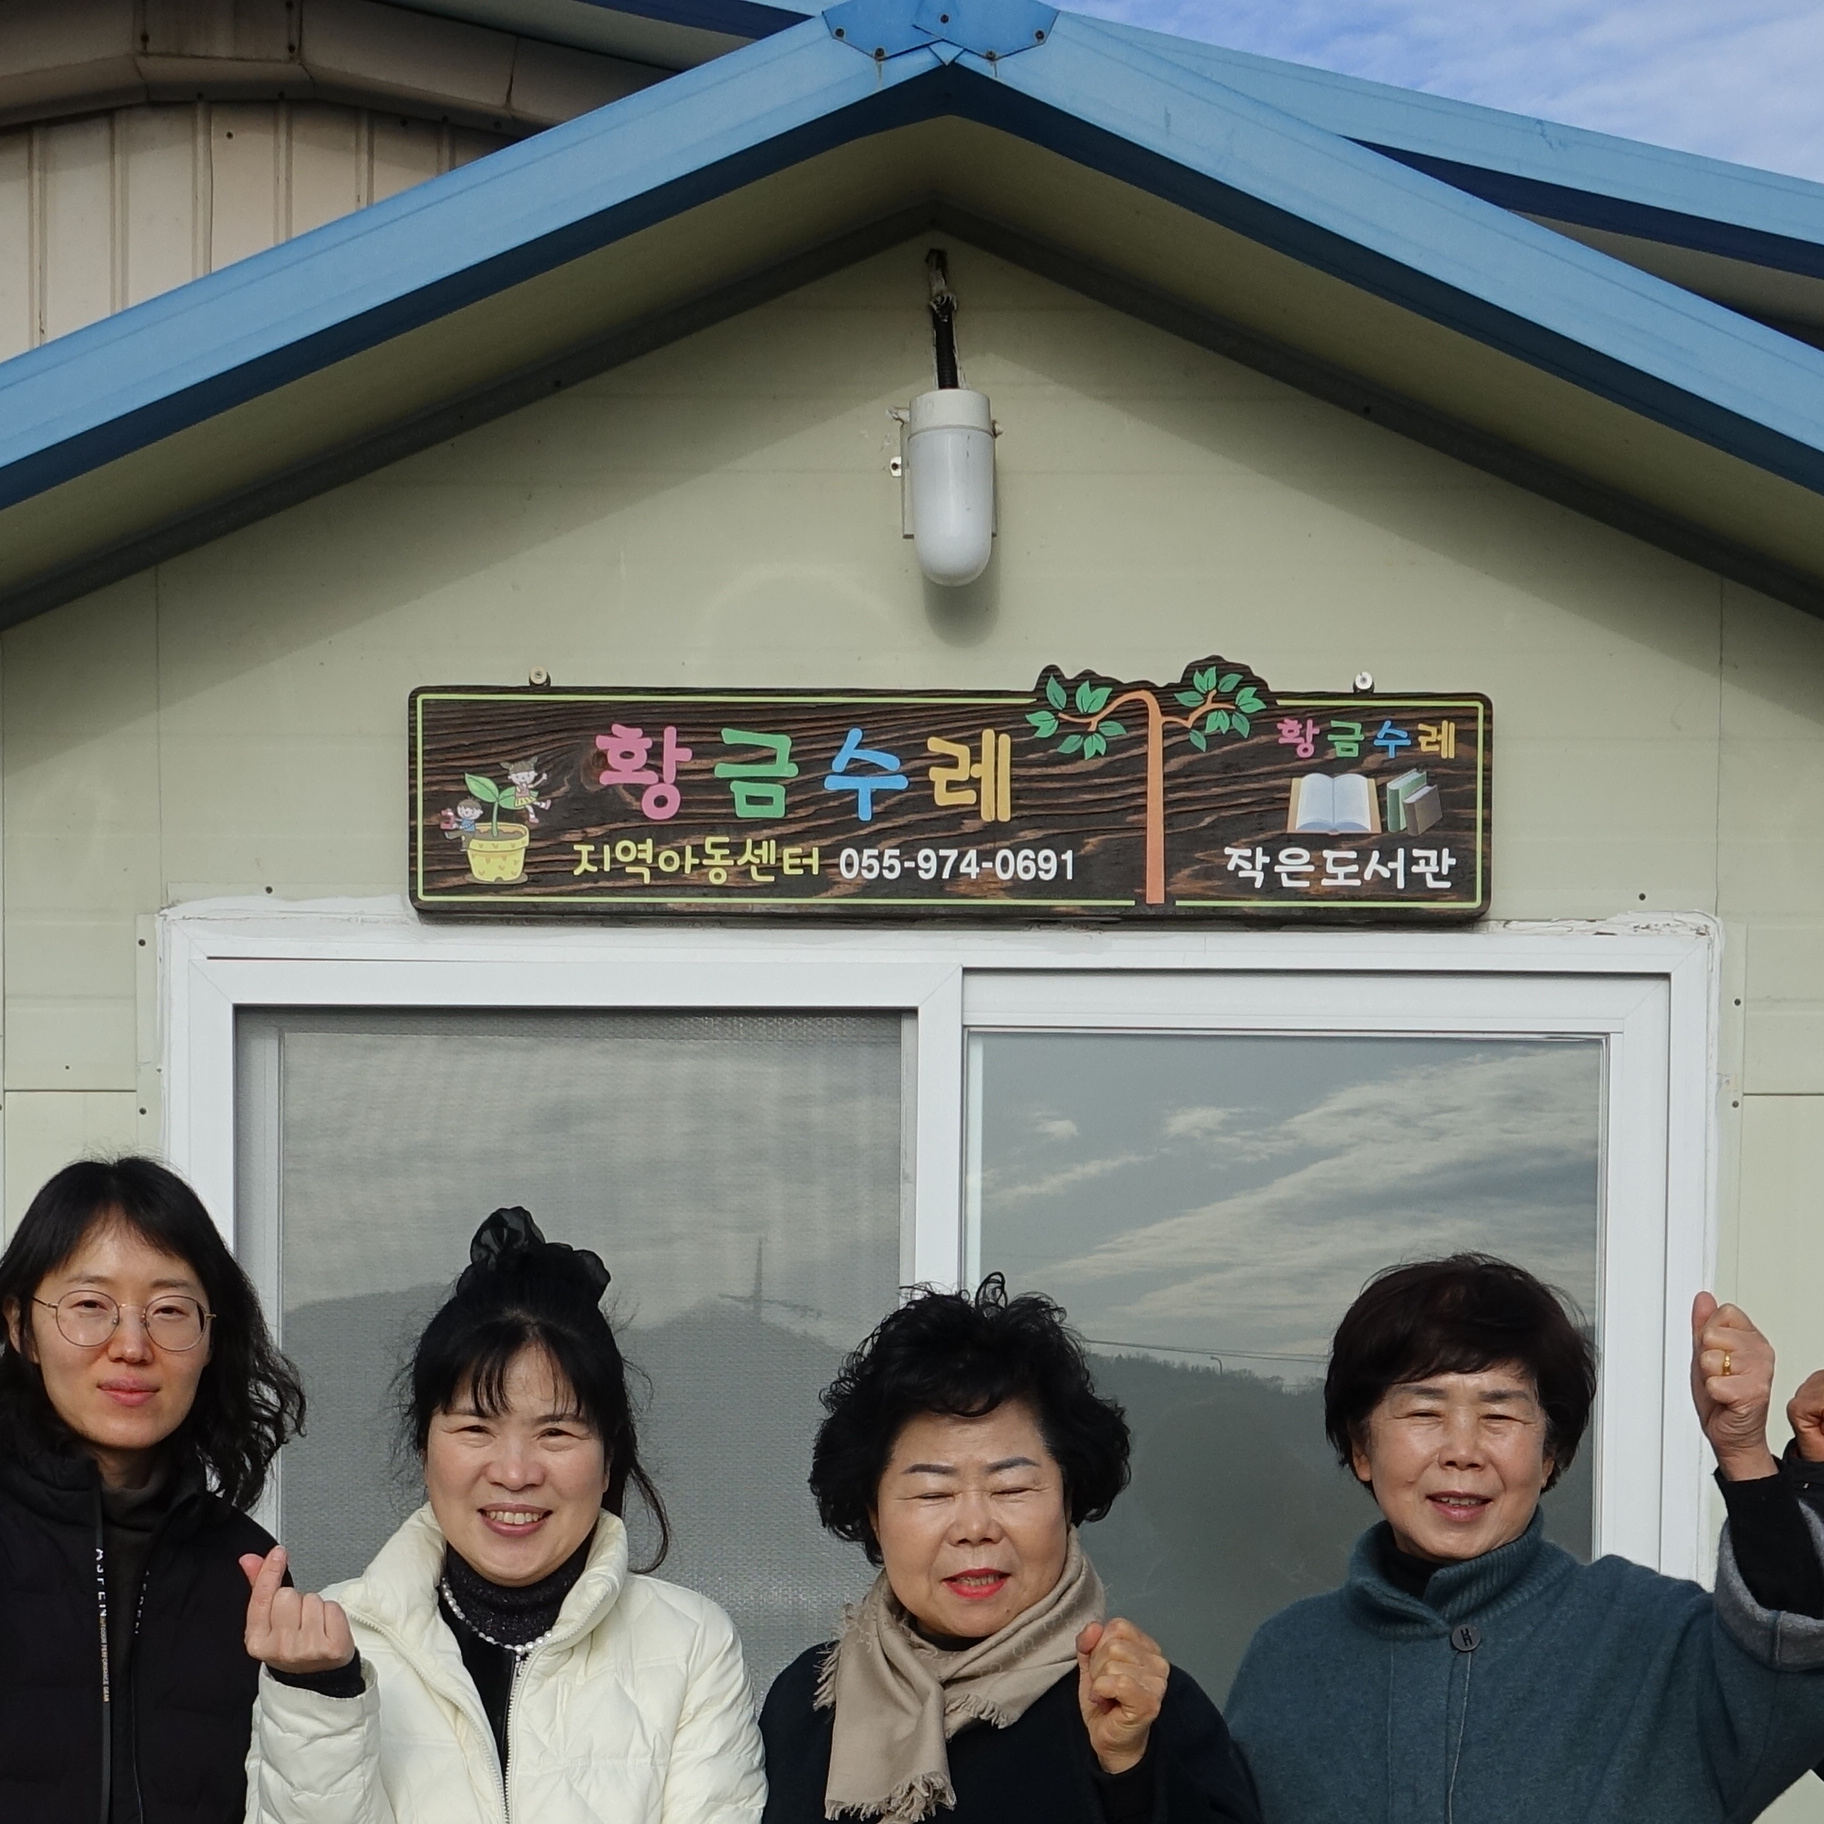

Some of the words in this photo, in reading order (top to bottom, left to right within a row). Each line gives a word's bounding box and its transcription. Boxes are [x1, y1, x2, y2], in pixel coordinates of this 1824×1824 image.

[1276, 718, 1456, 759] 황금수레
[595, 723, 1011, 822] 황금수레
[572, 838, 820, 885] 지역아동센터
[838, 847, 1075, 881] 055-974-0691
